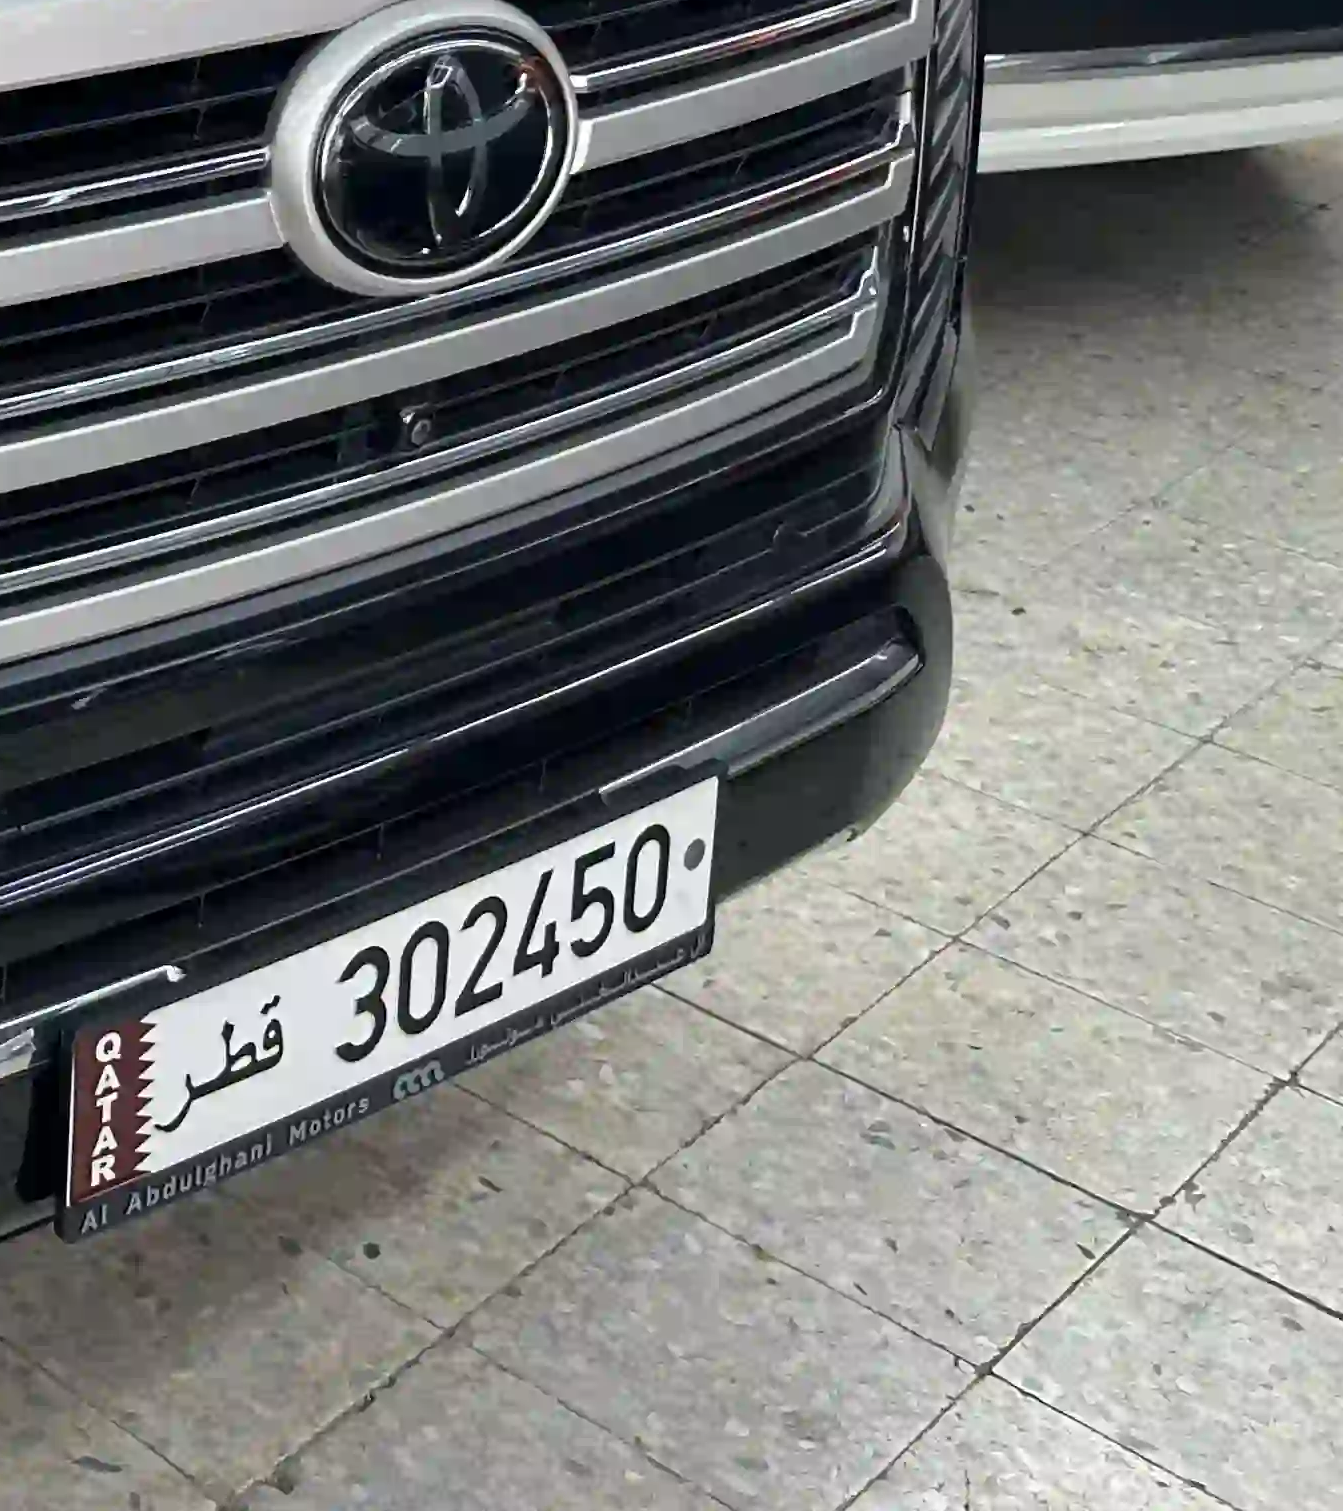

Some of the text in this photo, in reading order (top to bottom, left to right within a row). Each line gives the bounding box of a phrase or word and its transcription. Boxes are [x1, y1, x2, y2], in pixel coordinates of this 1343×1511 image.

[333, 822, 671, 1064] 302450
[89, 1031, 125, 1189] QATAR
[155, 993, 285, 1133] قطر
[80, 1093, 371, 1235] Al Abdulghani Motors
